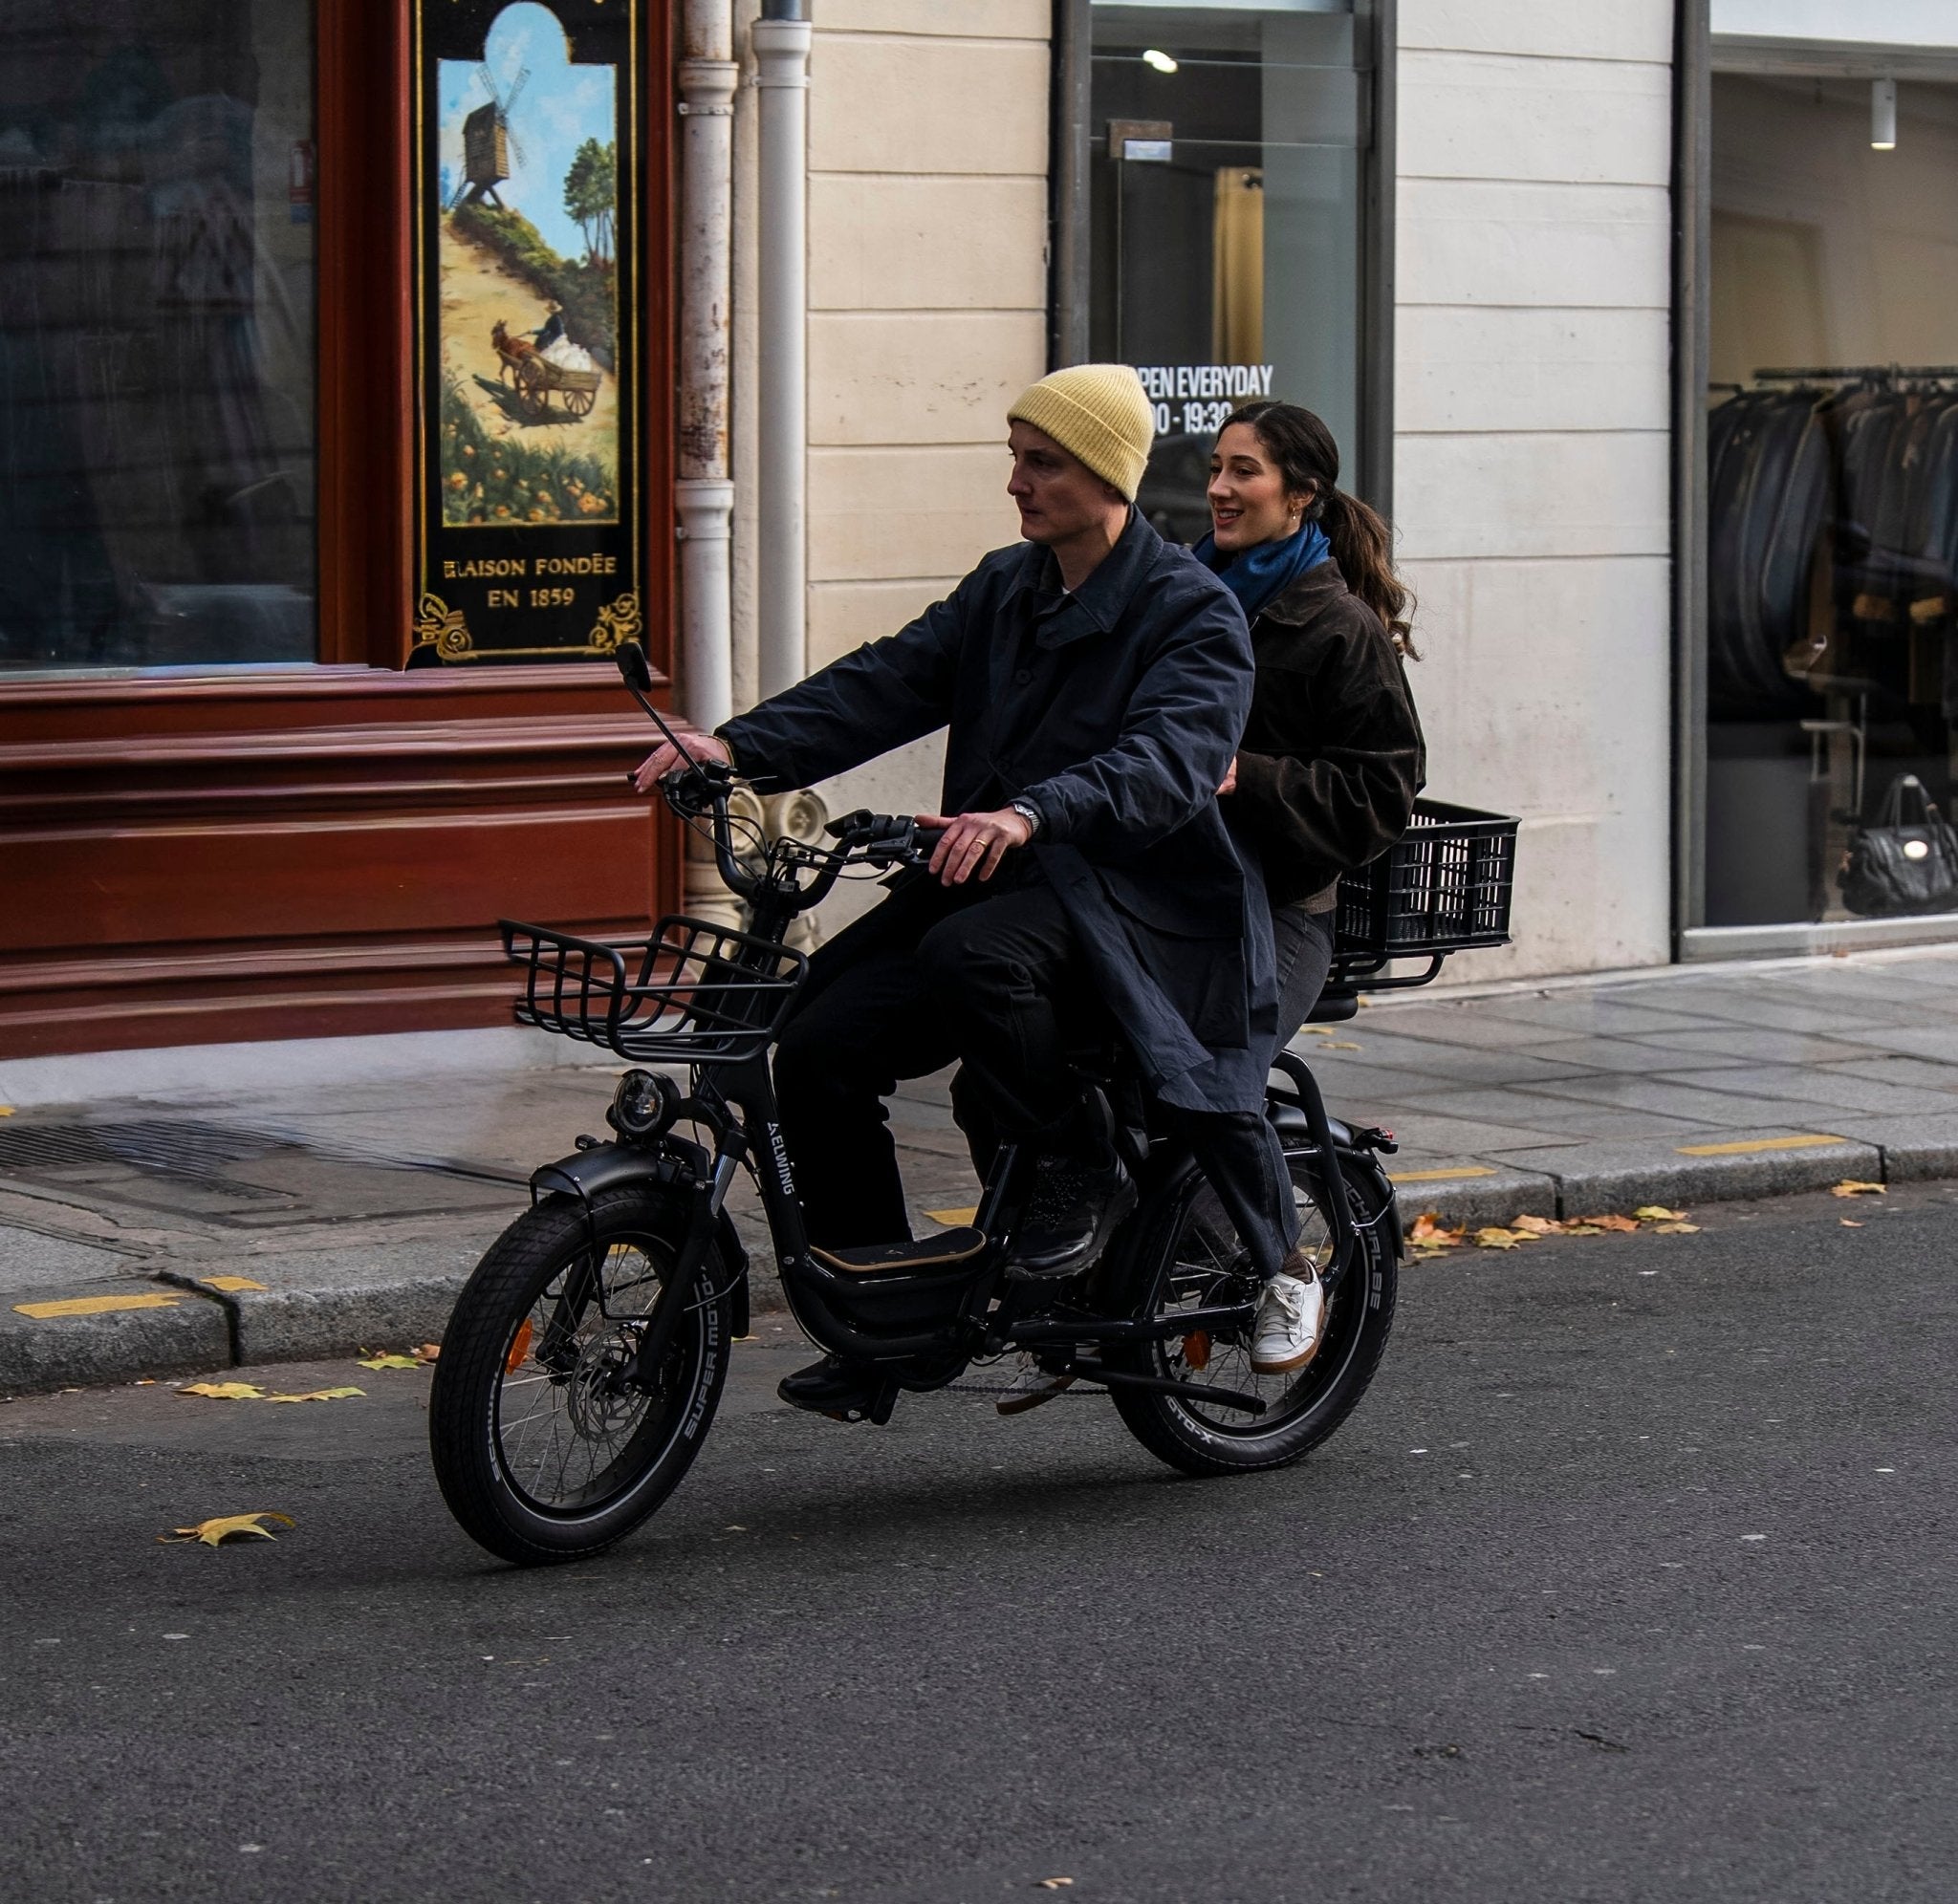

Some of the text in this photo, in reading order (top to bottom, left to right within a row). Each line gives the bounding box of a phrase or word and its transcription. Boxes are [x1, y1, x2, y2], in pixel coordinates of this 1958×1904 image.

[1138, 365, 1273, 398] PEN EVERYDAY
[488, 587, 575, 608] EN 1859
[684, 1351, 718, 1440] SUPER
[1164, 1395, 1213, 1445] OTO-X
